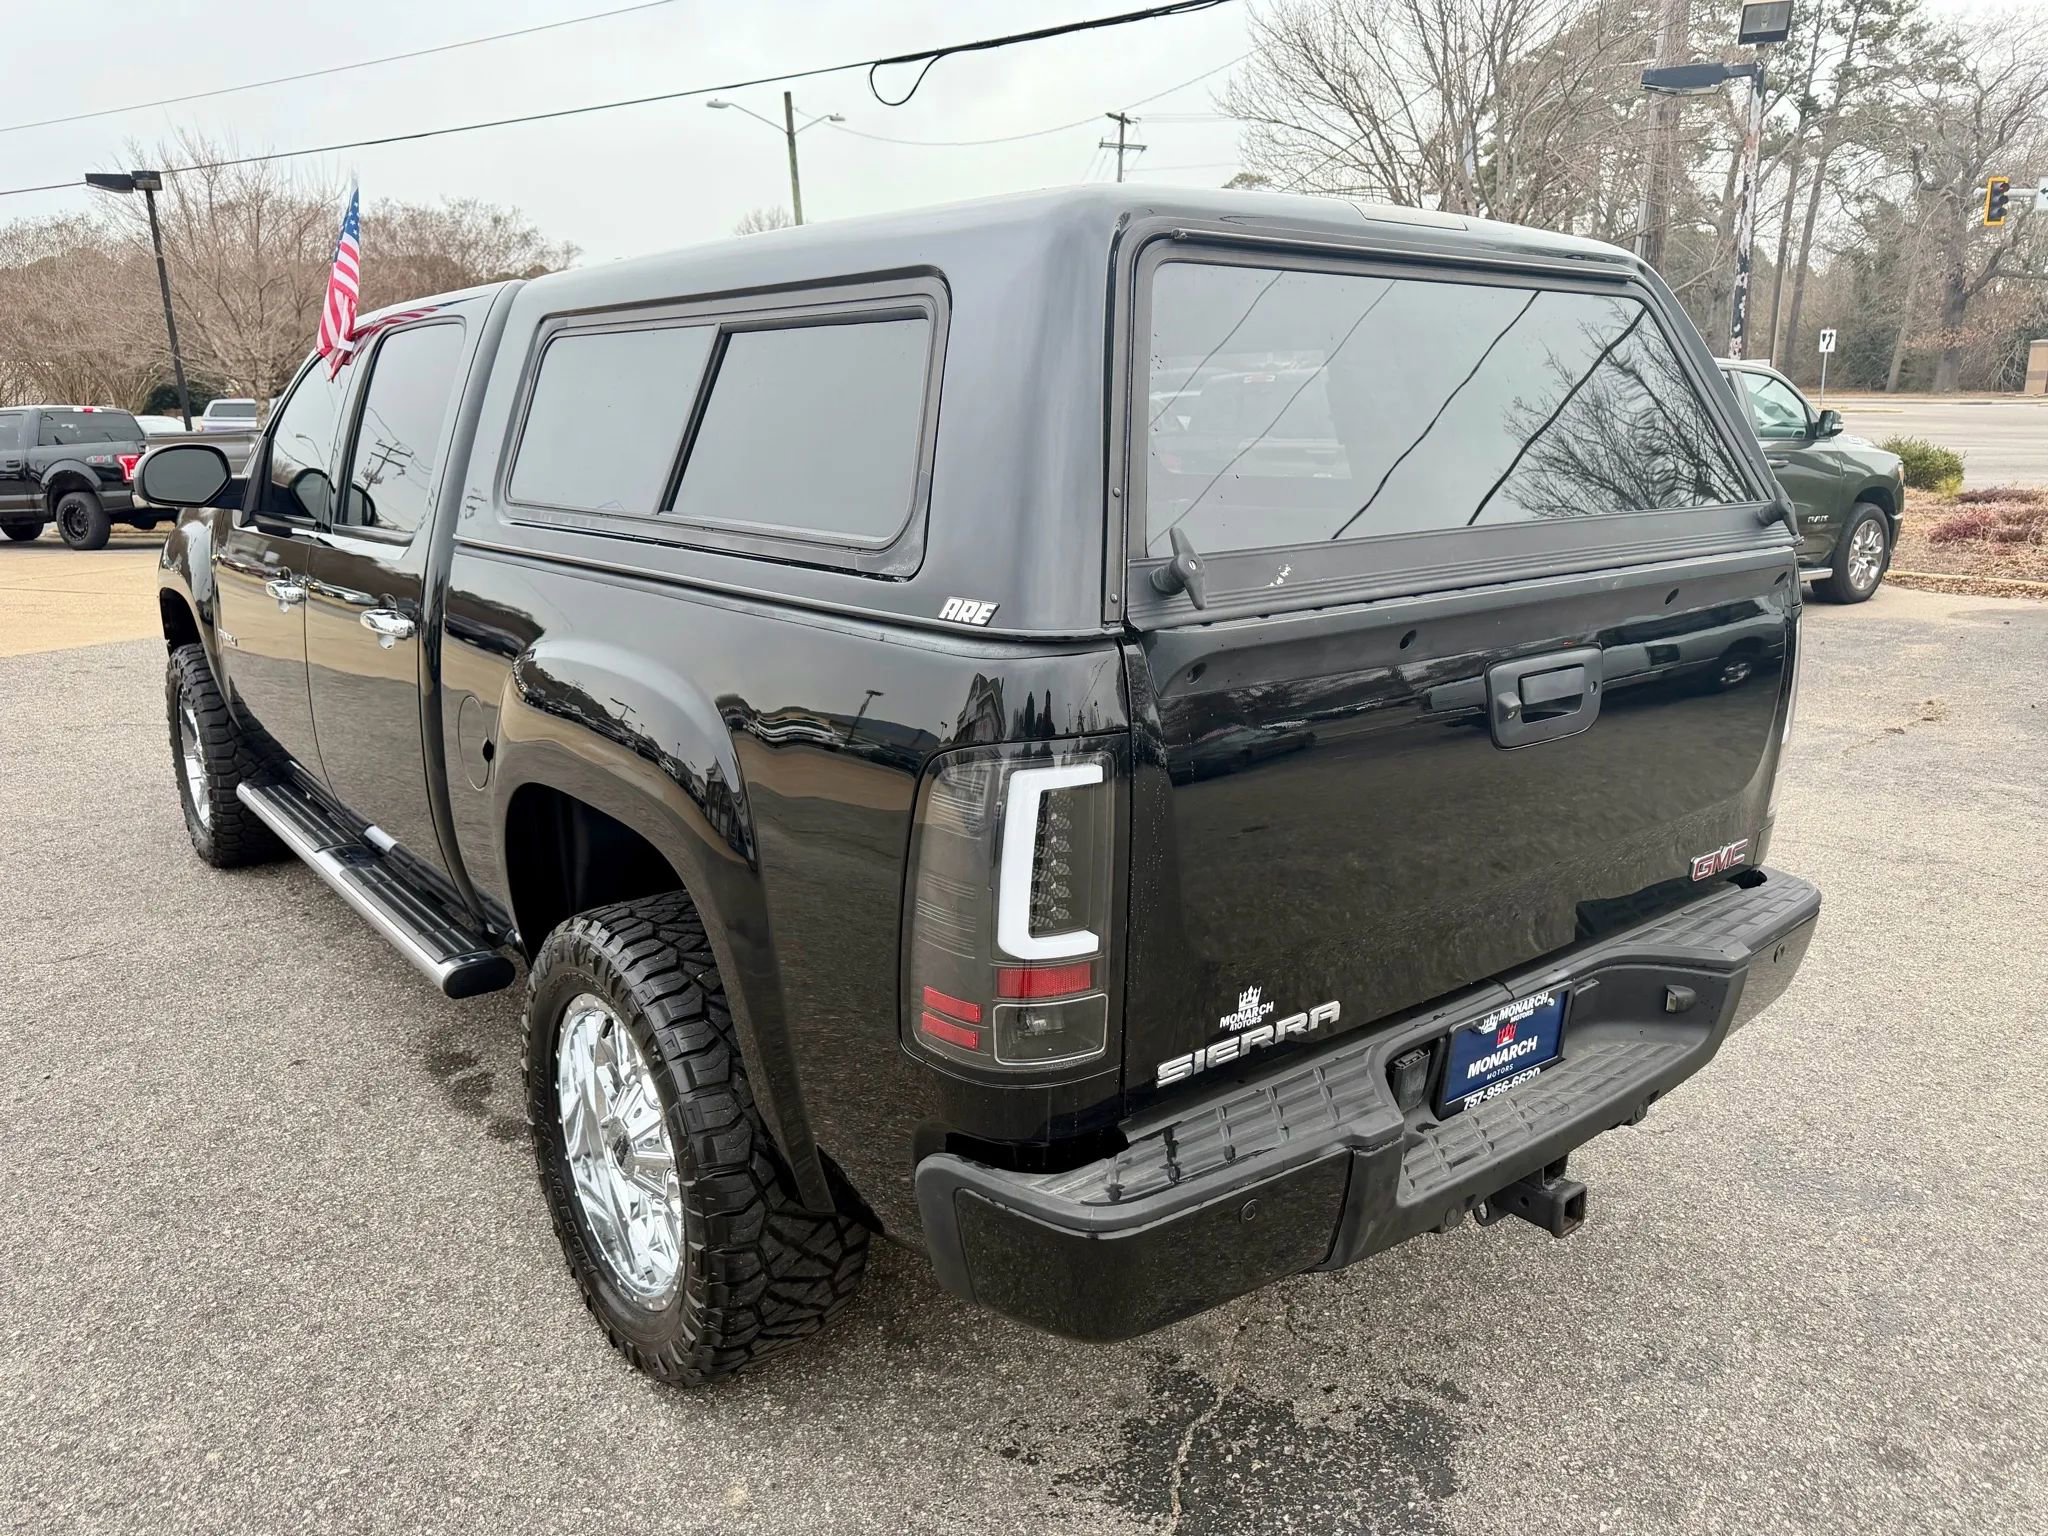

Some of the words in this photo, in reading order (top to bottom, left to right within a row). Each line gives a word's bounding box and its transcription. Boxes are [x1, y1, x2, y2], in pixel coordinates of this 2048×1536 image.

[938, 597, 999, 626] ARE
[1692, 838, 1748, 881] GMC
[1219, 1001, 1274, 1028] MONARCH
[1499, 991, 1549, 1021] MONARCH
[1509, 1008, 1535, 1023] MOTORS
[1229, 1015, 1263, 1031] MOTORS
[1156, 1000, 1341, 1088] SIERRA
[1467, 1035, 1538, 1079] MONARCH
[1486, 1063, 1514, 1080] MOTORS
[1463, 1067, 1541, 1111] 757-956-6620
